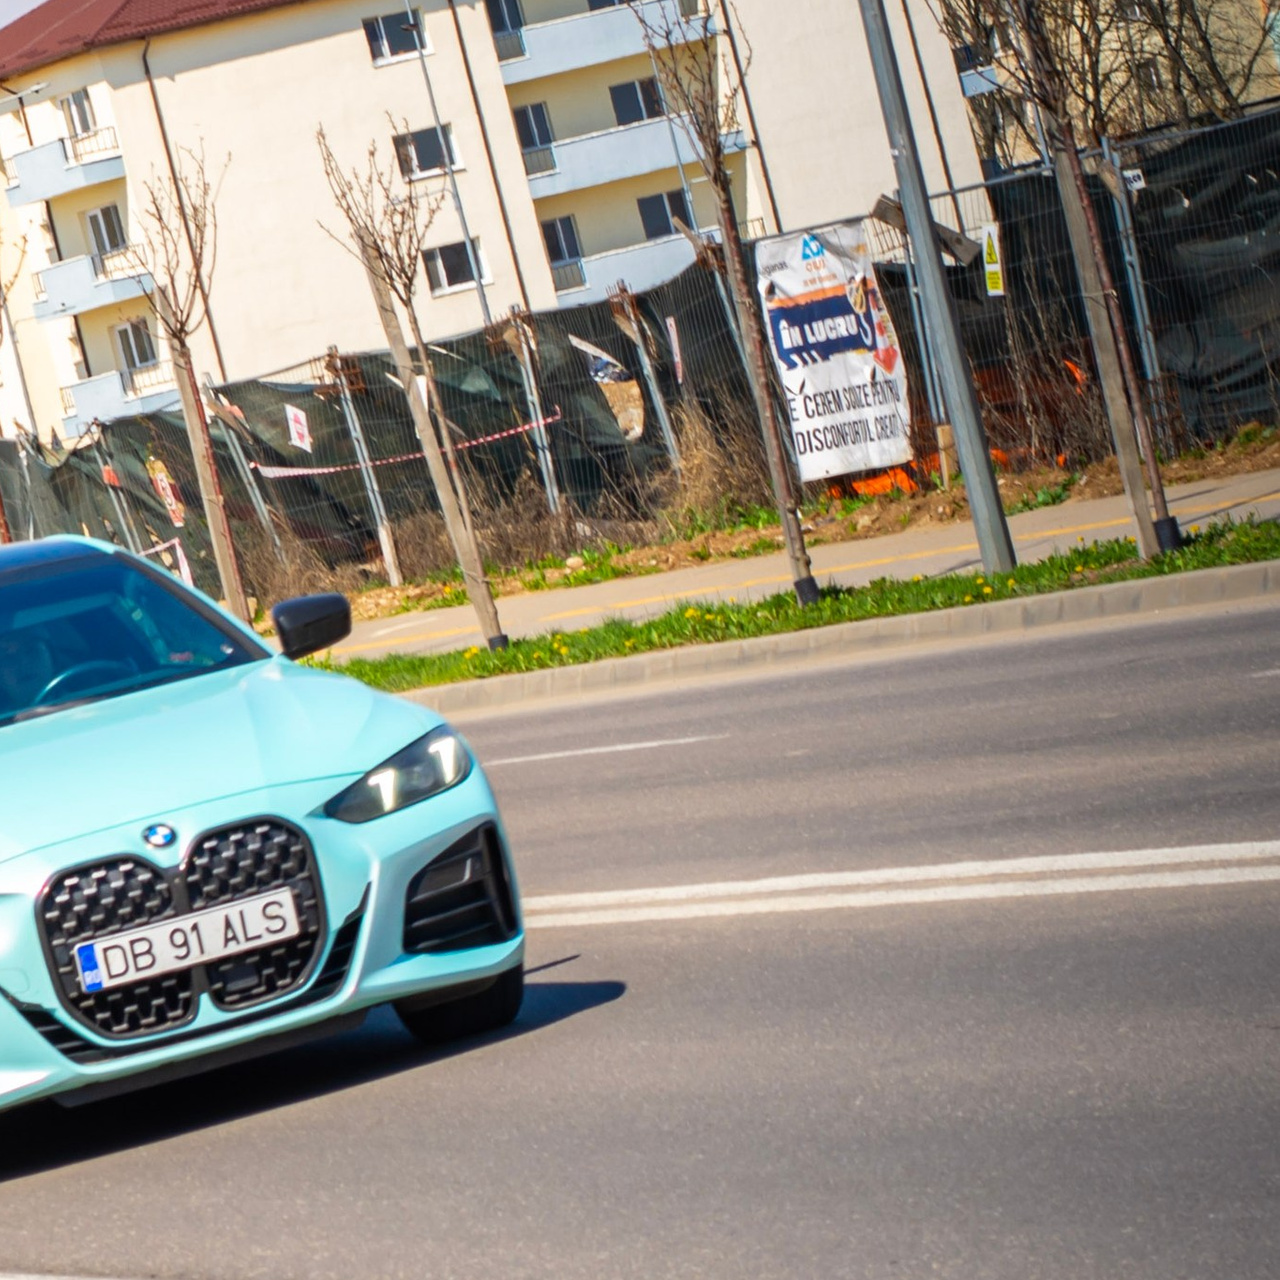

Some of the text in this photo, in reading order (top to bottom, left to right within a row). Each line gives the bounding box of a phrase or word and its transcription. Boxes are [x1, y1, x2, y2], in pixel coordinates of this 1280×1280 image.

[780, 313, 858, 349] ÎN LUCRU
[803, 389, 844, 418] CEREM
[795, 419, 874, 455] DISCONFORTUL
[102, 900, 288, 980] DB 91 ALS
